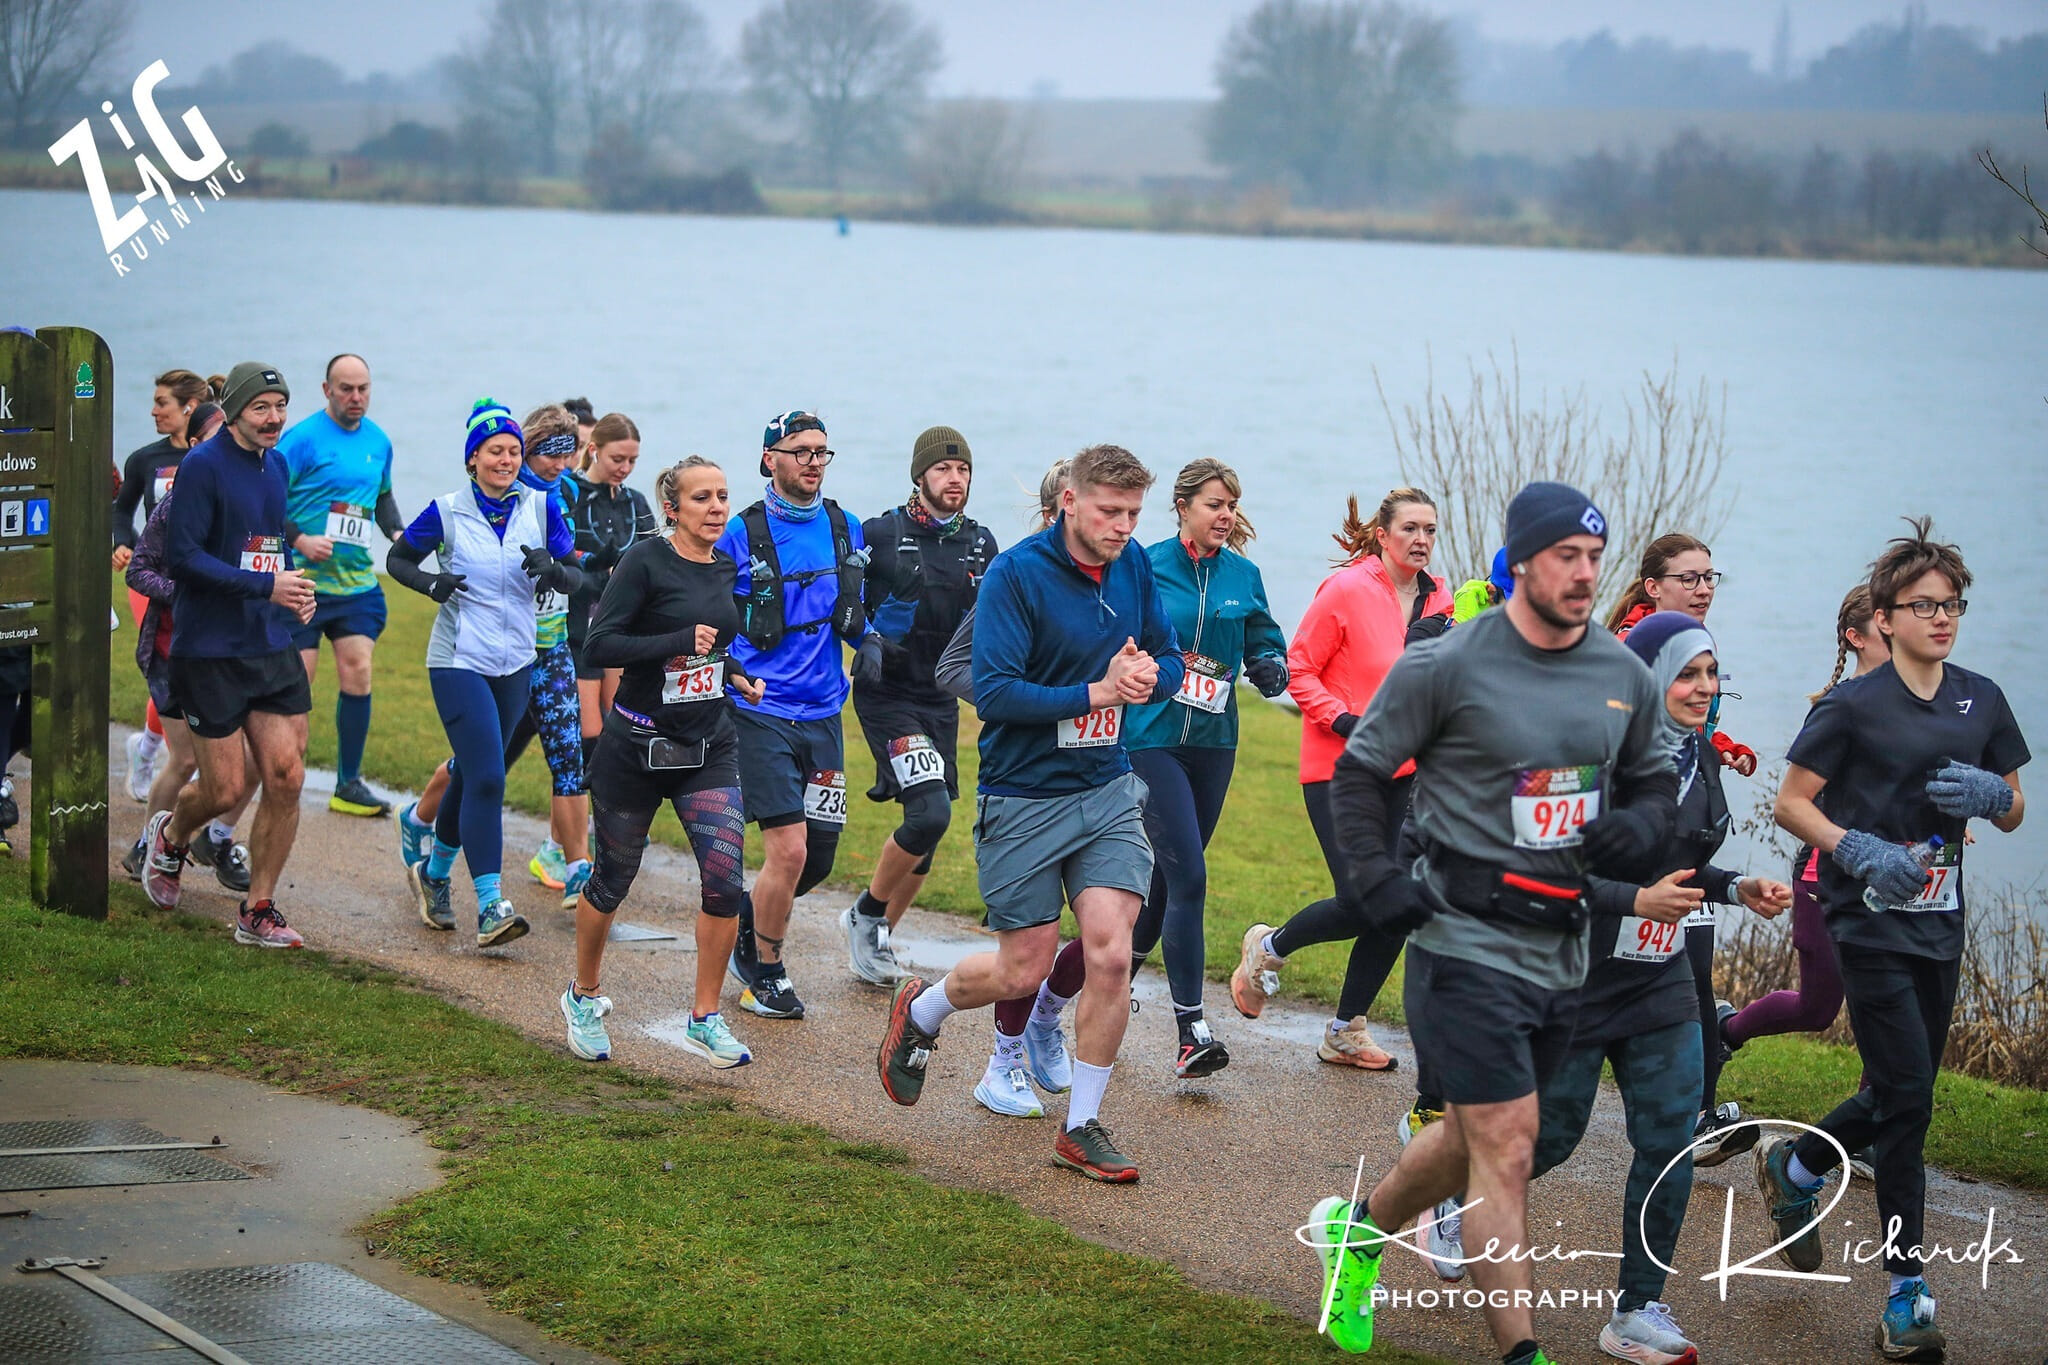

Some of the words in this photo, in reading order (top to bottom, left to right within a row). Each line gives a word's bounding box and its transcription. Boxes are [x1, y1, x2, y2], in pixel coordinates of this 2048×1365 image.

[0, 452, 37, 472] dows
[340, 517, 363, 538] 101
[252, 555, 279, 572] 926
[0, 626, 39, 640] trust.org.uk
[677, 667, 715, 695] 933
[1074, 708, 1116, 739] 928
[904, 751, 939, 777] 209
[815, 788, 848, 815] 238
[1533, 797, 1585, 838] 924
[1637, 919, 1678, 953] 942
